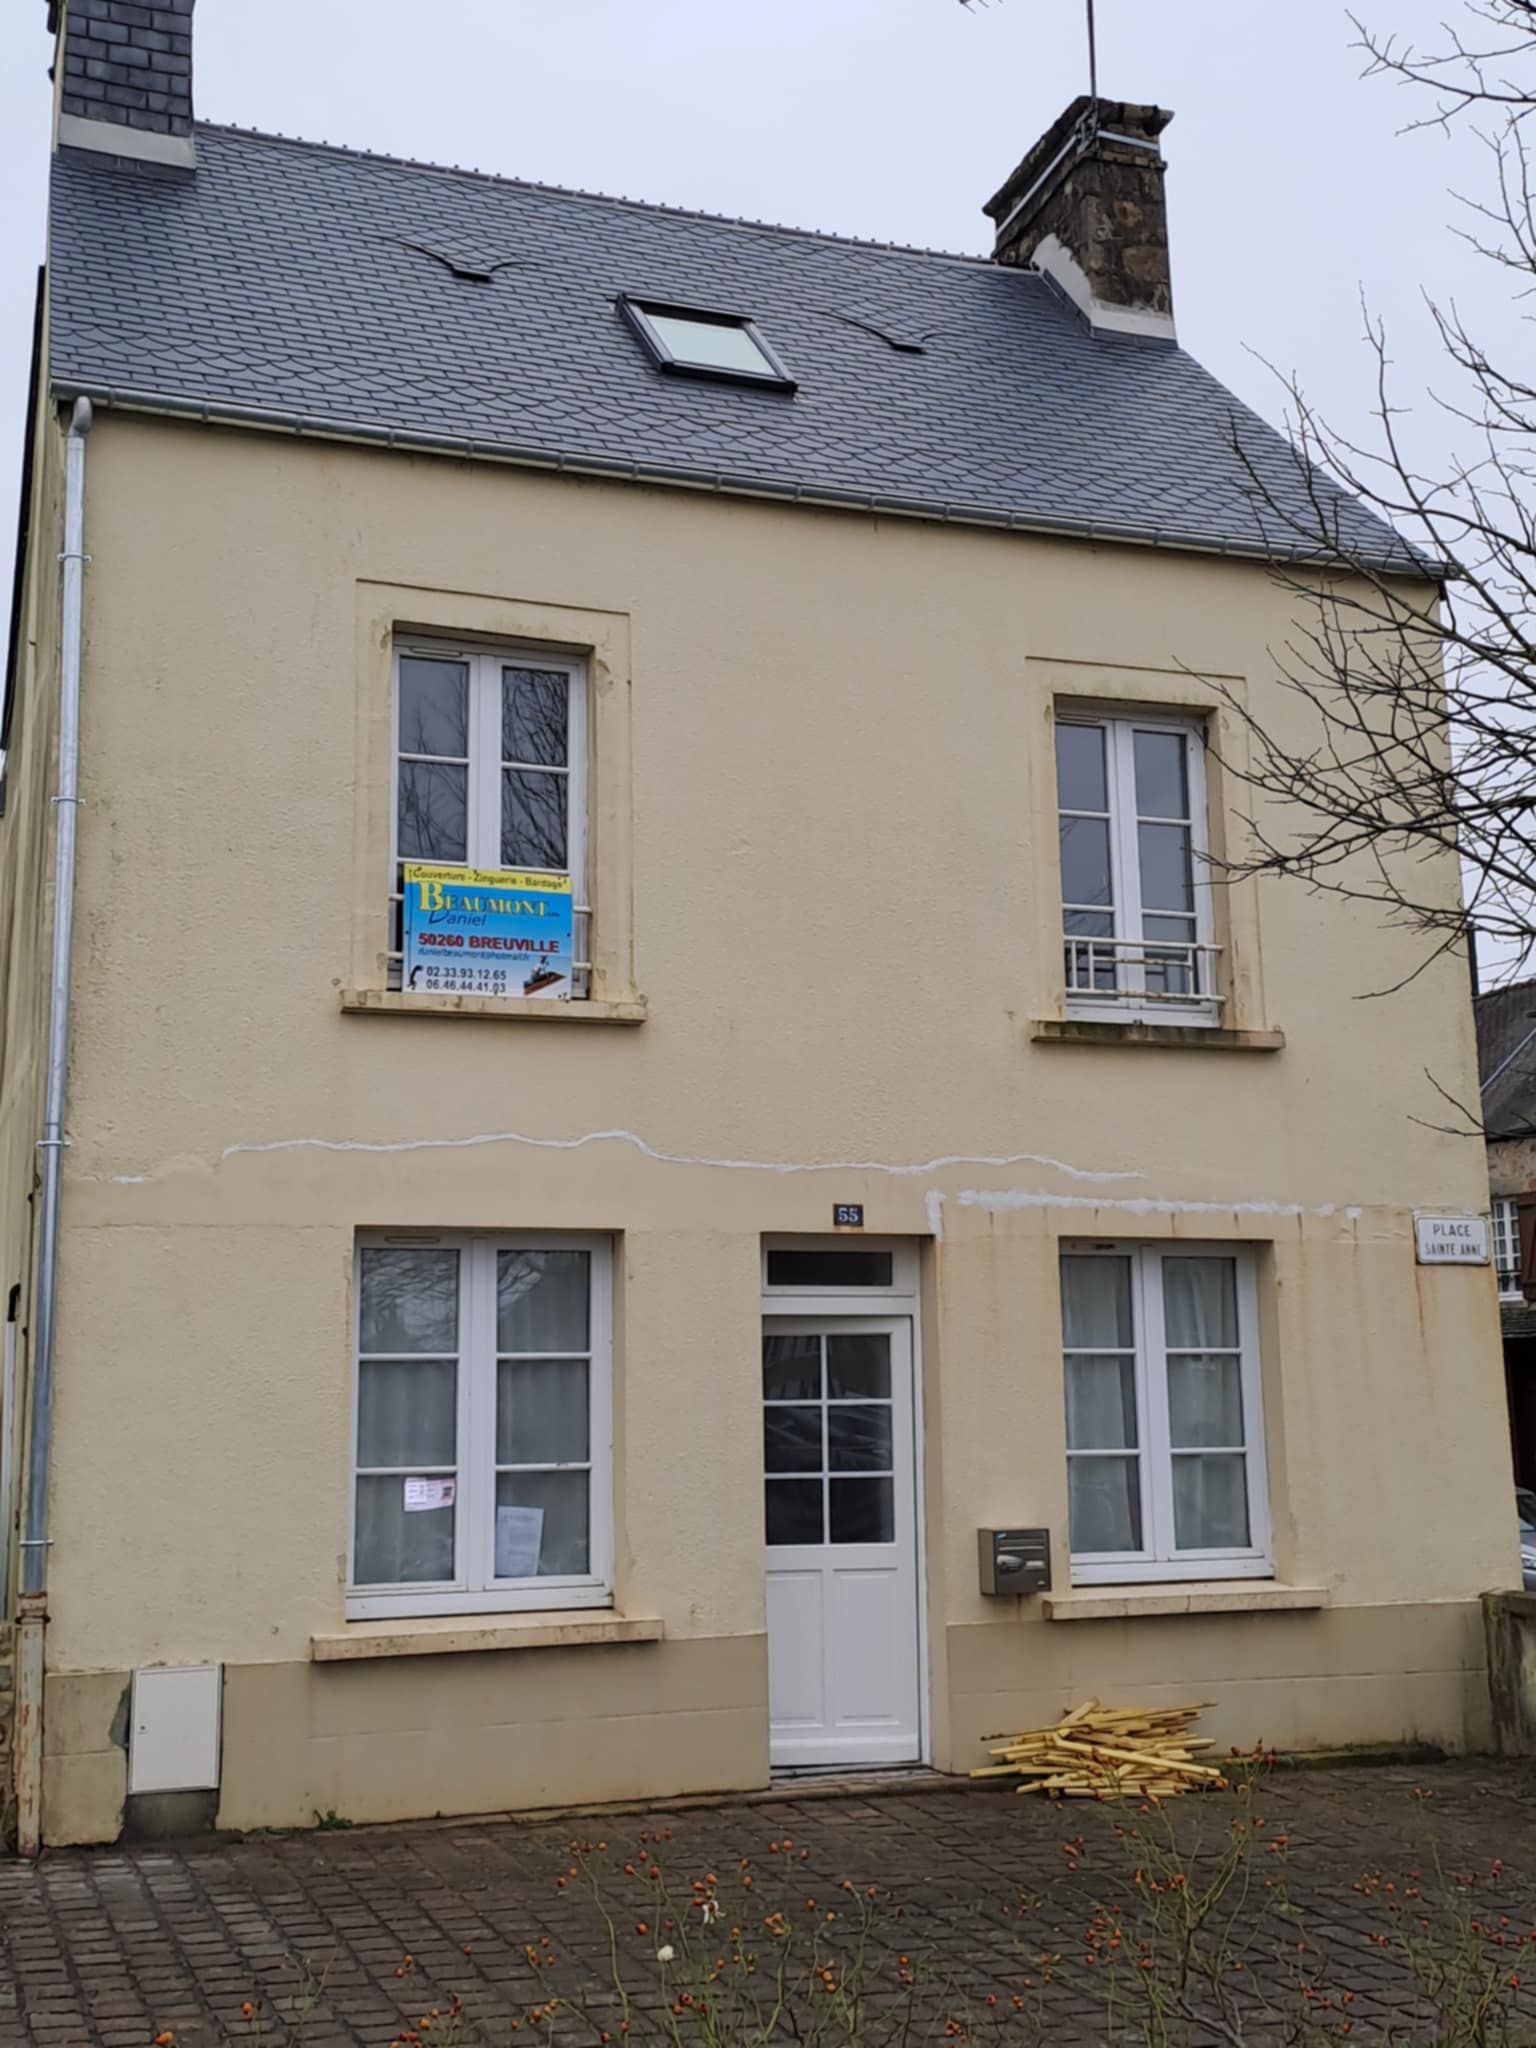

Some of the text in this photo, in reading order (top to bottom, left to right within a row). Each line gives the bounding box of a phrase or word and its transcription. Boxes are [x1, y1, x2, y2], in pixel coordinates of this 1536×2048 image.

[413, 867, 465, 881] Couverture
[473, 871, 521, 885] Zinguerie
[418, 881, 549, 916] BEAUMONT
[428, 910, 487, 926] Daniel
[418, 933, 560, 953] 50260 BREUVILLE
[426, 966, 507, 980] 02.33.93.12.65
[838, 1207, 859, 1223] 55
[1433, 1224, 1472, 1237] PLACE
[1425, 1243, 1481, 1256] SAINTE ANNE
